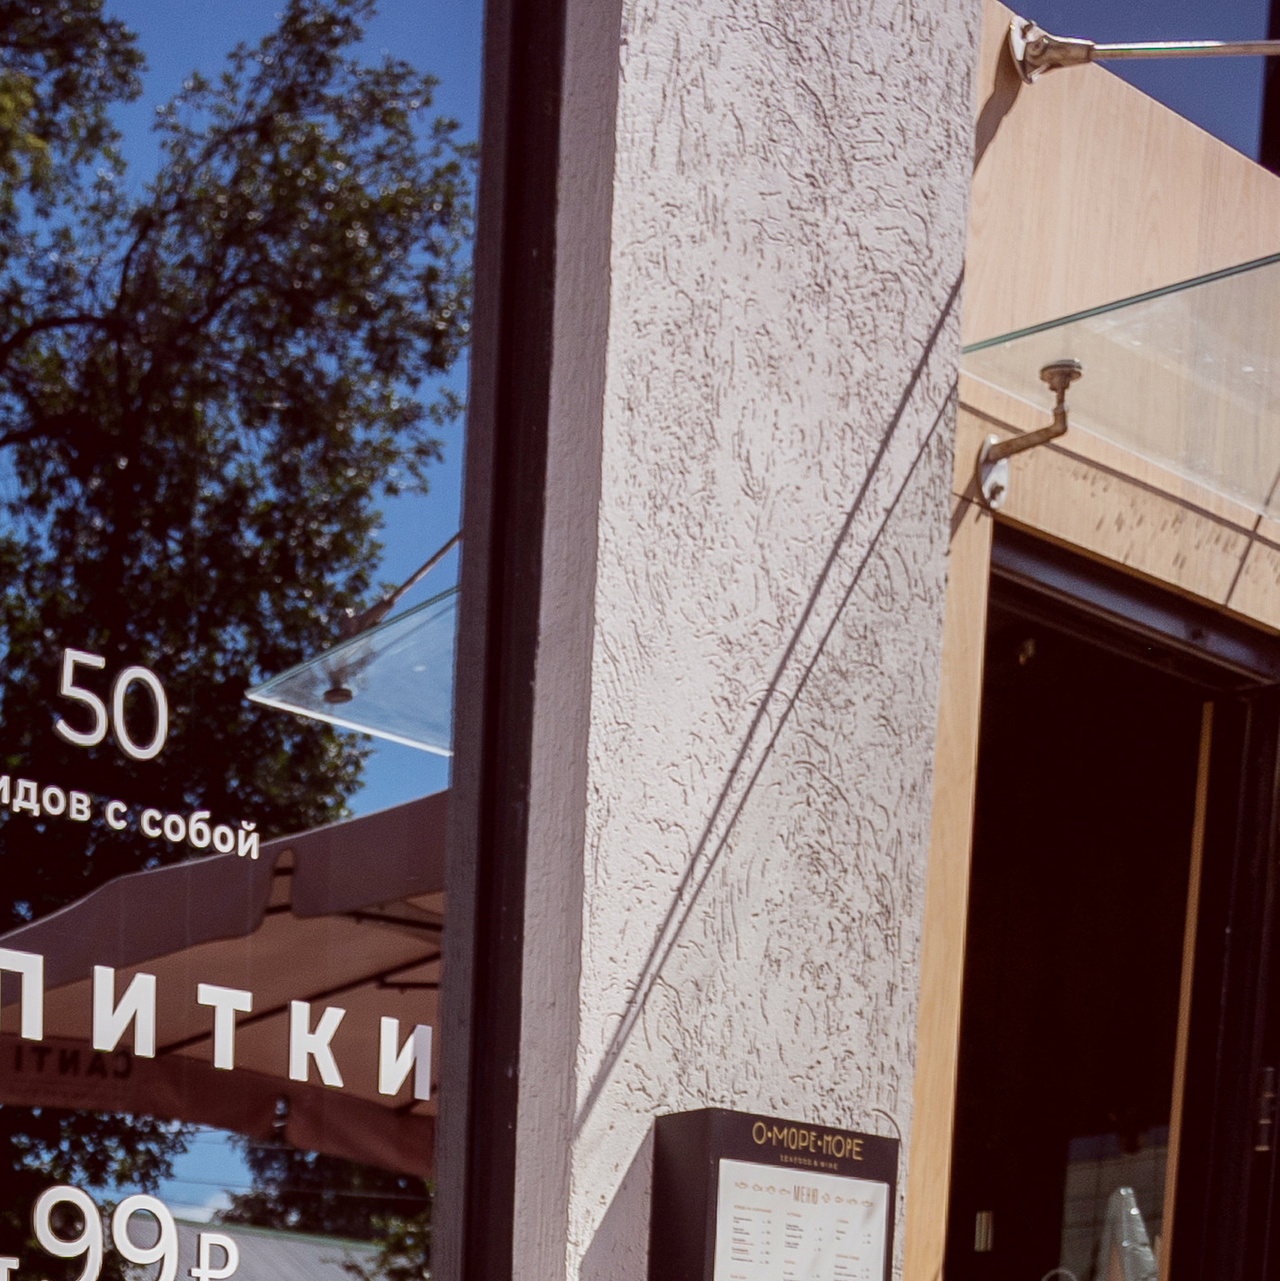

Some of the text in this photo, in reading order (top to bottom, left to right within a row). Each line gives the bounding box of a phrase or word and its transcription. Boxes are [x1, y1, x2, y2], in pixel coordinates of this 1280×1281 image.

[56, 647, 168, 760] 50
[105, 800, 128, 831] с
[141, 808, 260, 860] собой
